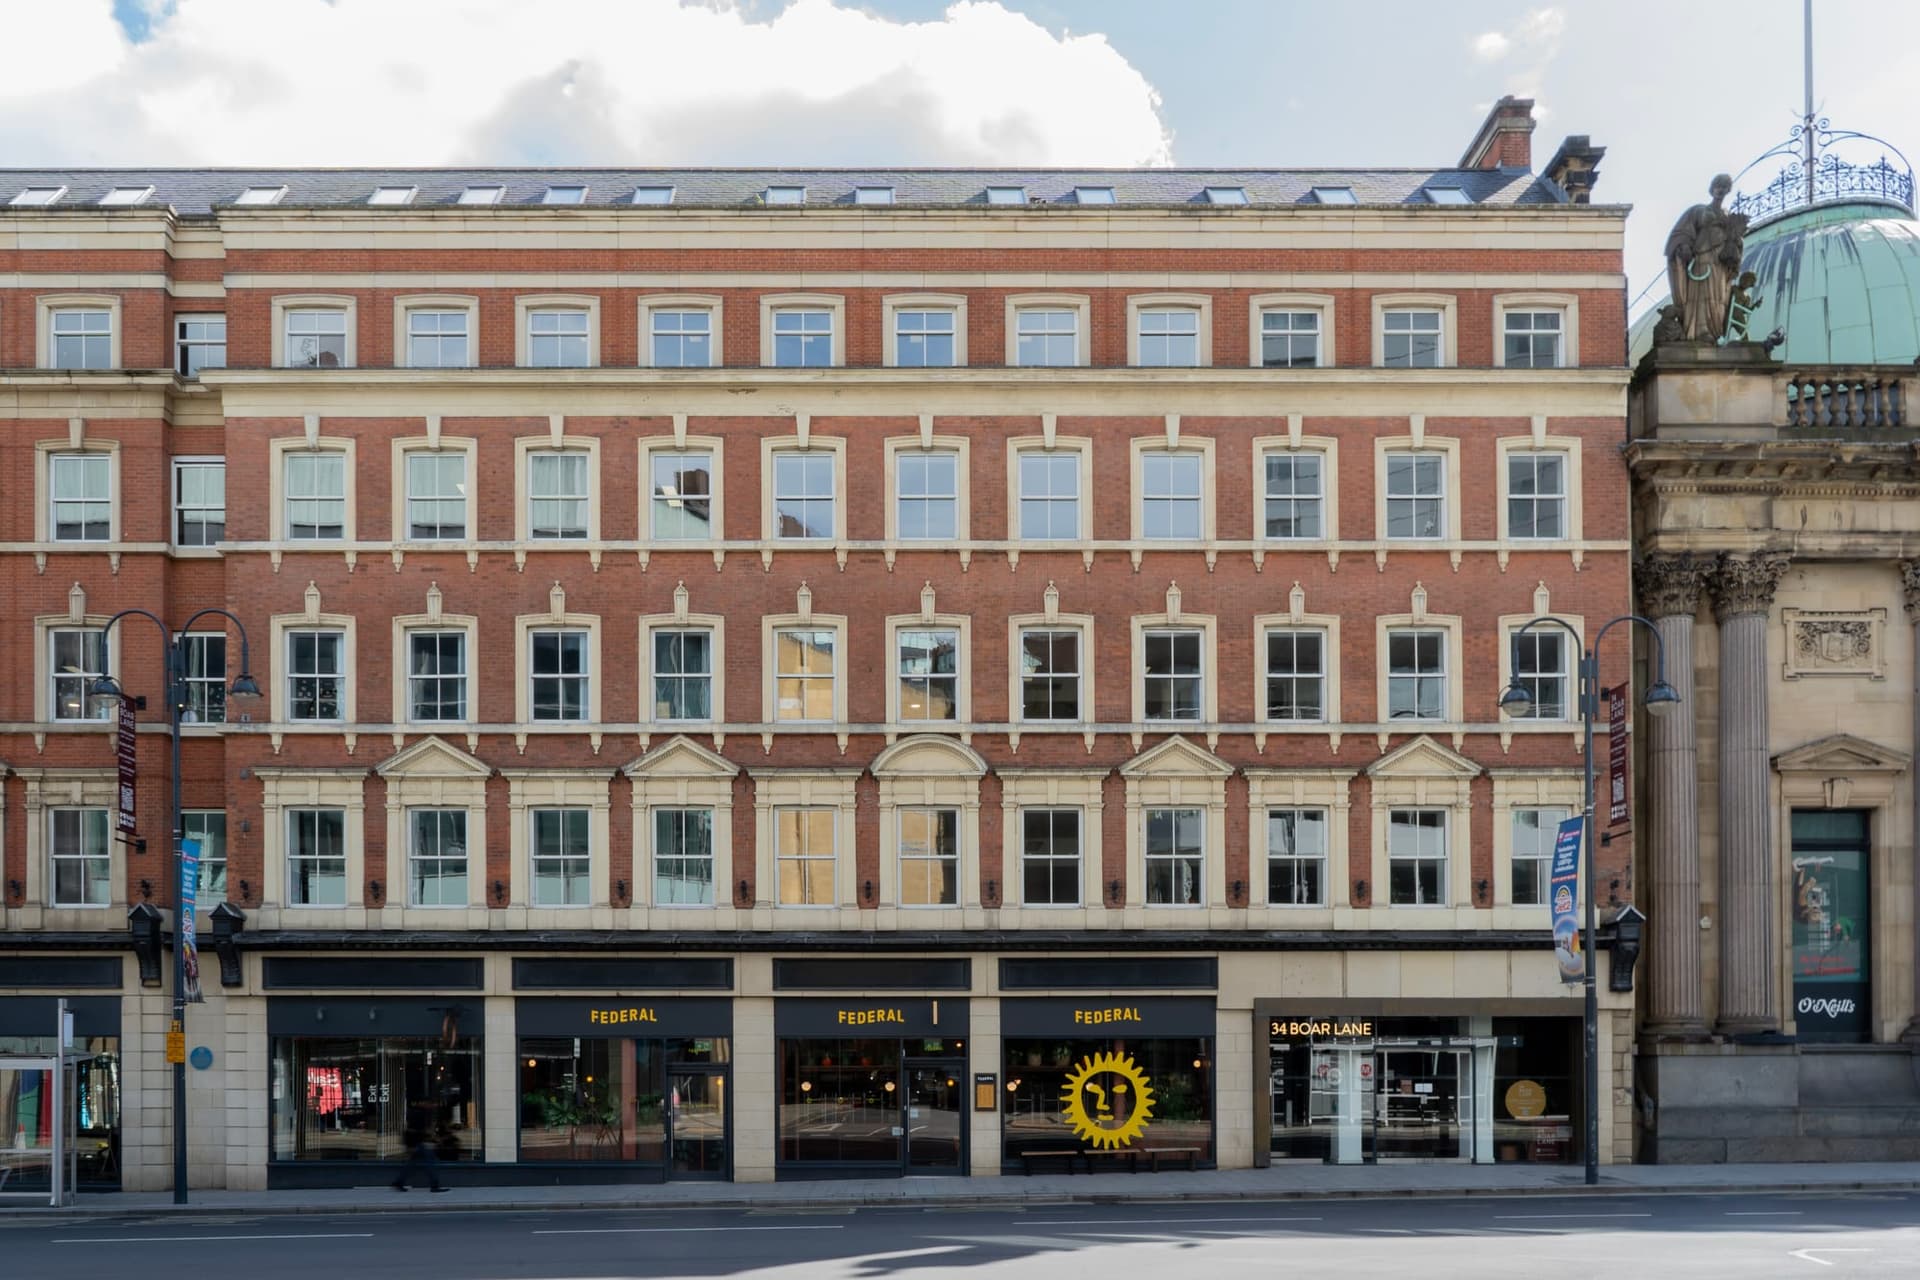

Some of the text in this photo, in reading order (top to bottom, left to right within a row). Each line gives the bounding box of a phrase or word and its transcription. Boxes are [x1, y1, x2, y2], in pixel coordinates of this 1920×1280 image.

[590, 1008, 658, 1024] FEDERAL
[838, 1009, 905, 1025] FEDERAL
[1074, 1007, 1142, 1025] FEDERAL
[1271, 1022, 1373, 1035] 34 BOAR LANE
[368, 1085, 377, 1103] Exit
[379, 1083, 390, 1103] Exit
